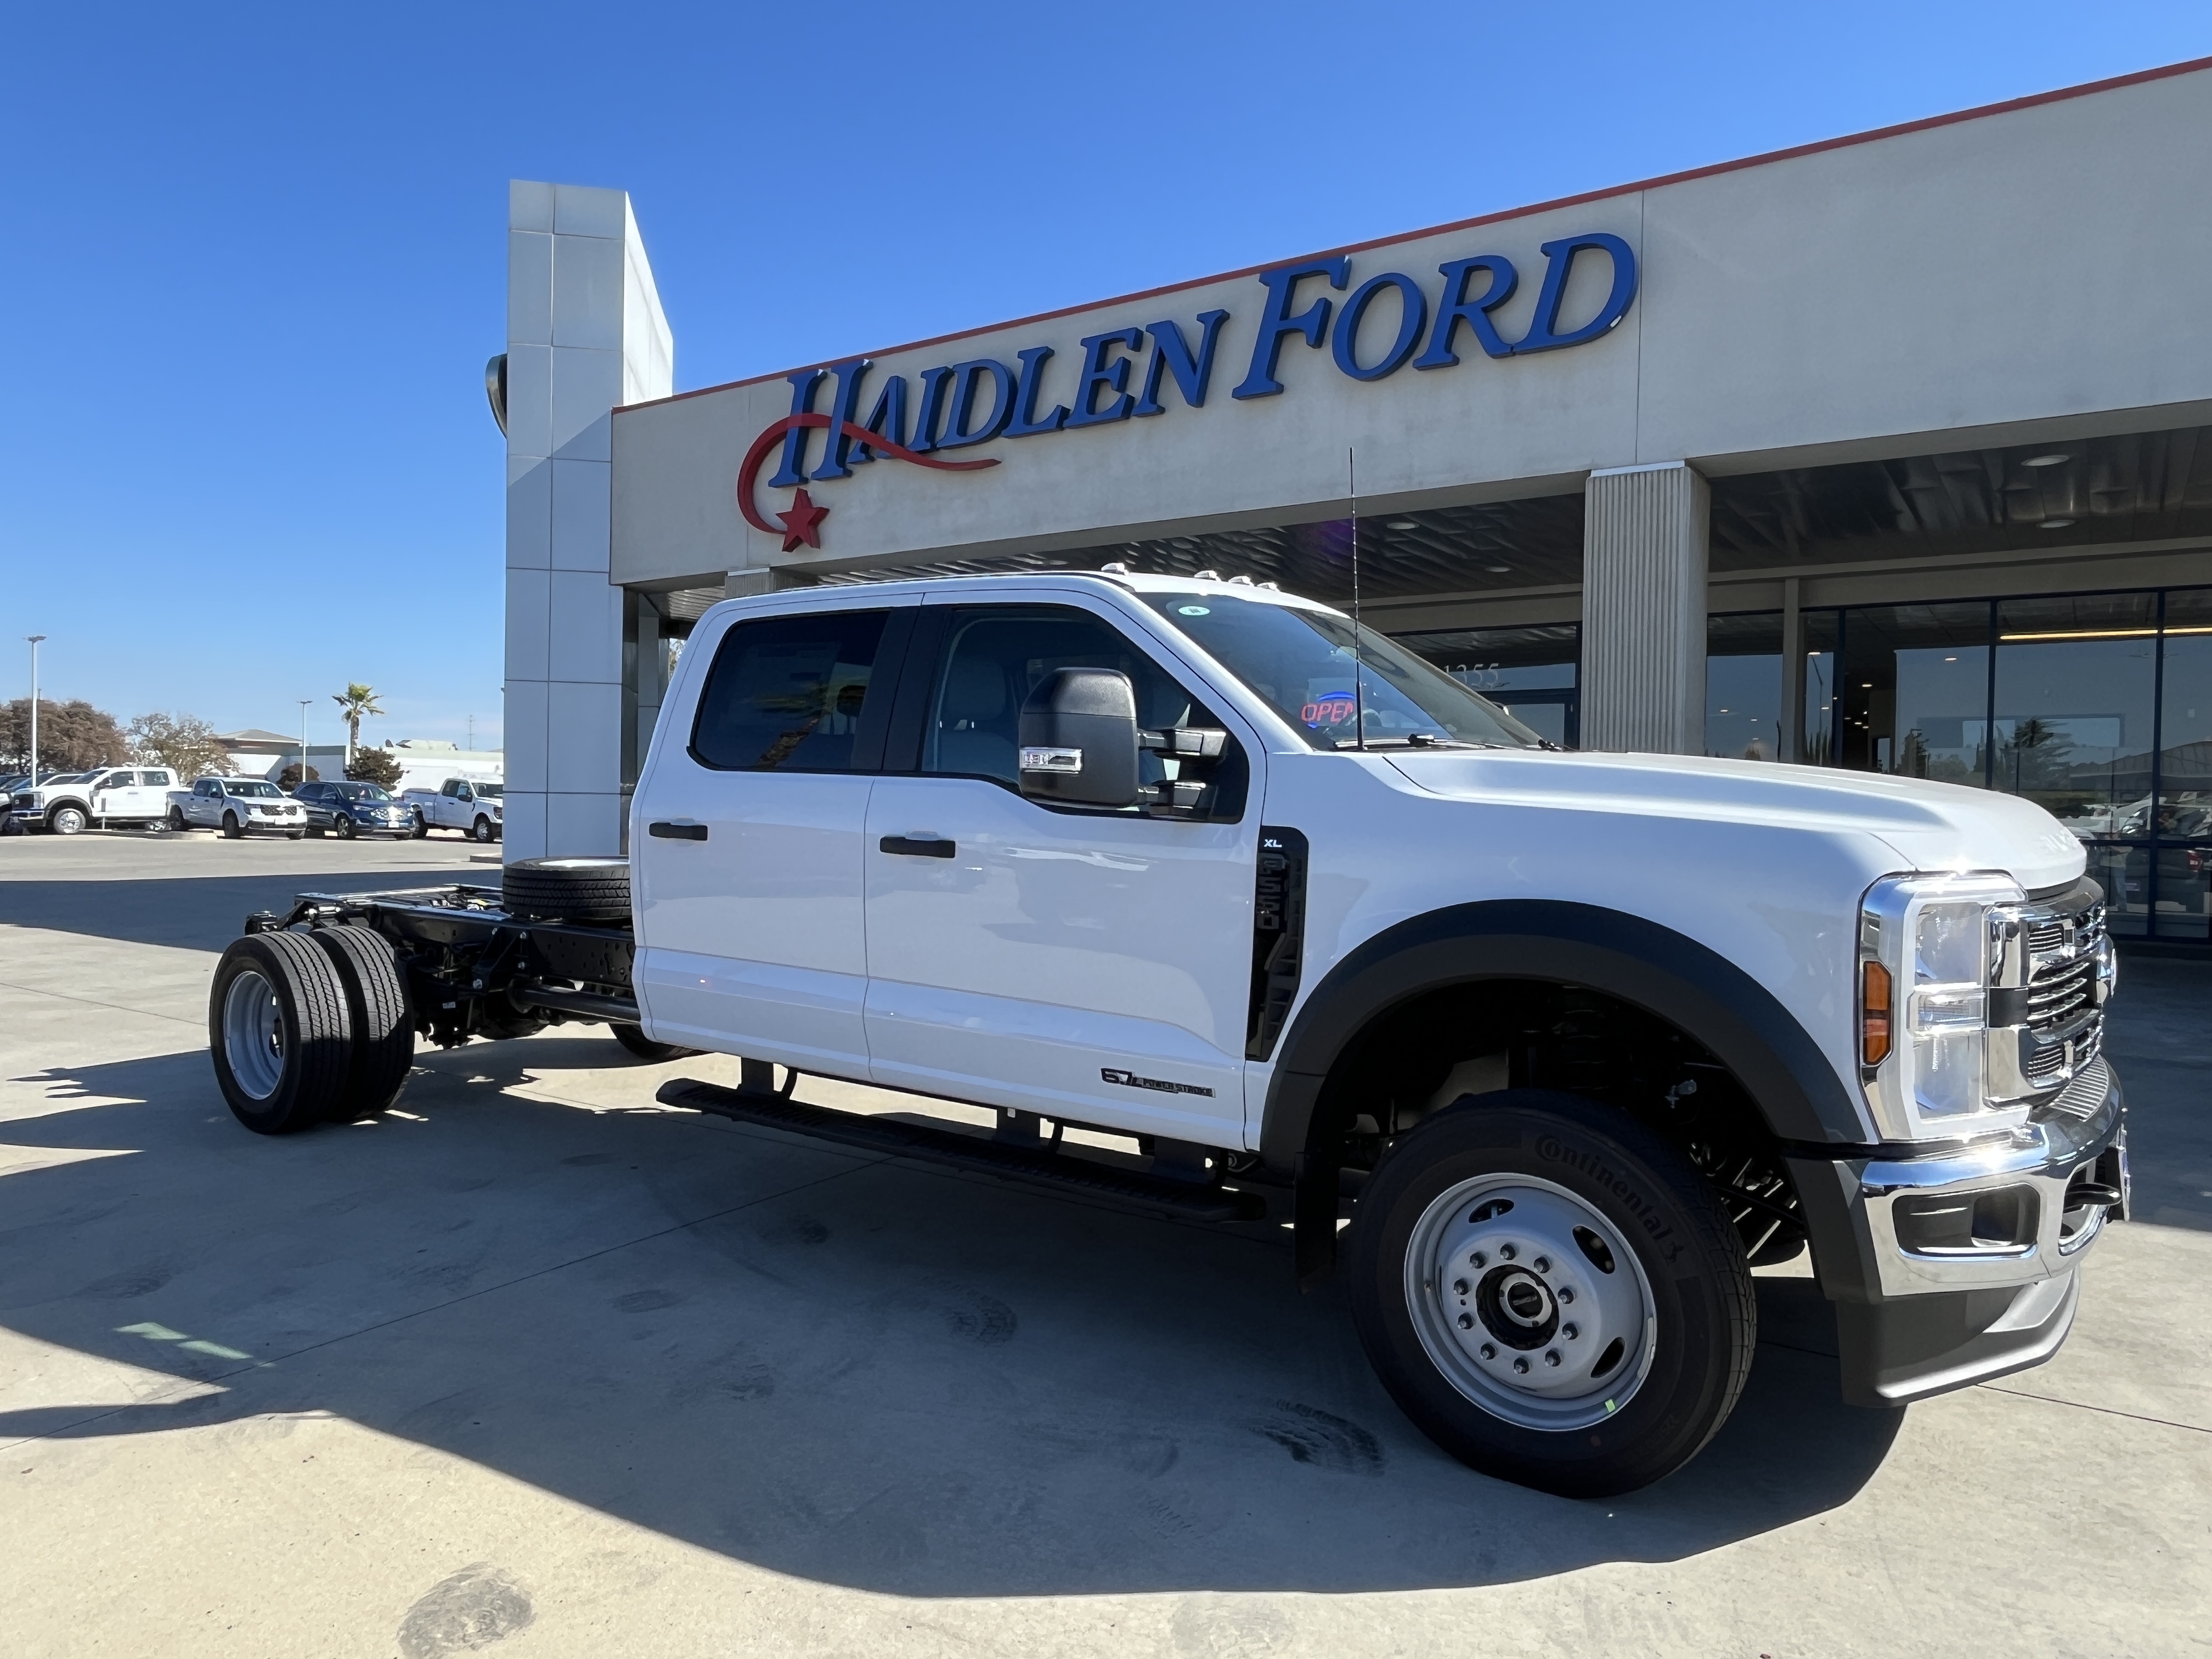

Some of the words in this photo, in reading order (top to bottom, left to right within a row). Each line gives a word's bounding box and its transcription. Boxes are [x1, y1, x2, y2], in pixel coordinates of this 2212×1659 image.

[769, 309, 1230, 488] HAIDLEN
[1232, 233, 1639, 400] FORD
[1263, 838, 1283, 848] XL
[1534, 1133, 1674, 1242] Continental
